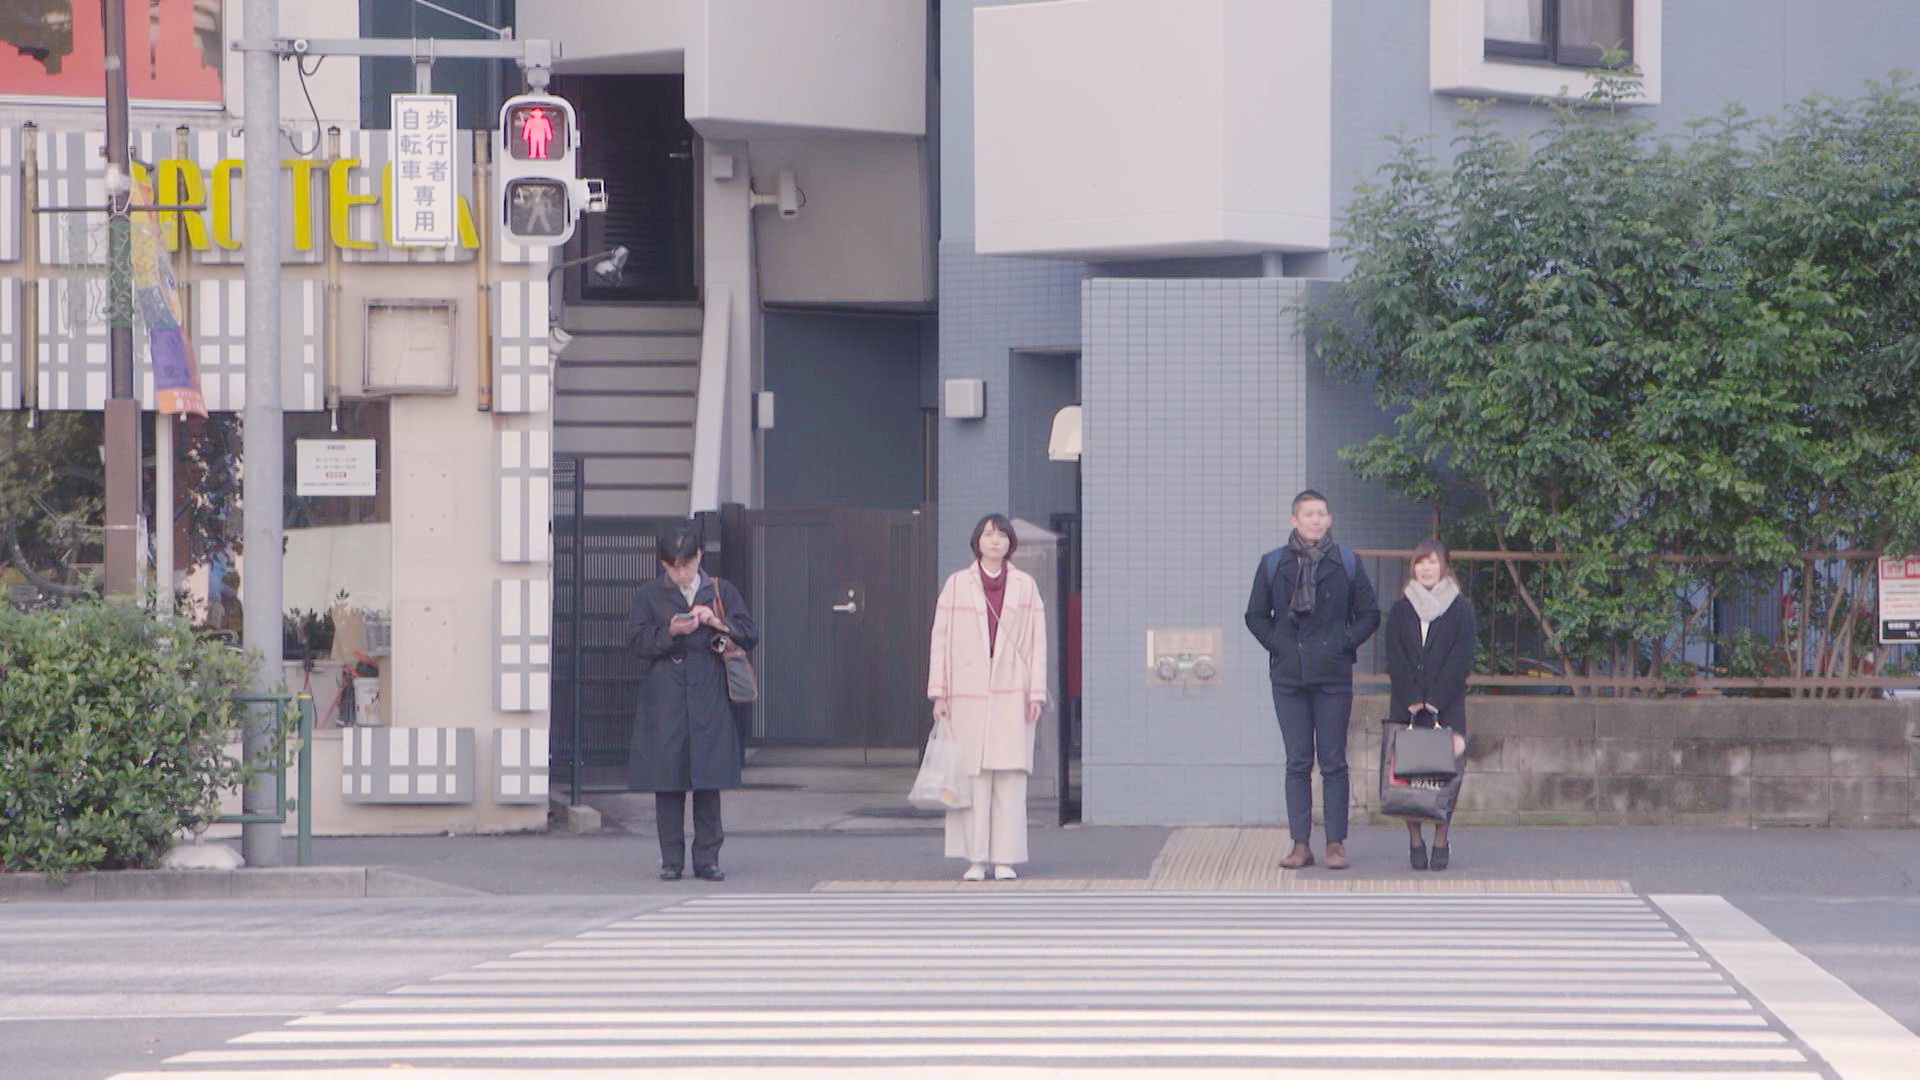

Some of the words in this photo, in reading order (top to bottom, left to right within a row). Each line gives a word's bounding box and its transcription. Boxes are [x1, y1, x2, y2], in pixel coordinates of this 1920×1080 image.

[400, 108, 422, 181] 自転車
[426, 108, 448, 182] 歩行者
[130, 157, 481, 251] ROTE
[413, 185, 436, 232] 専用
